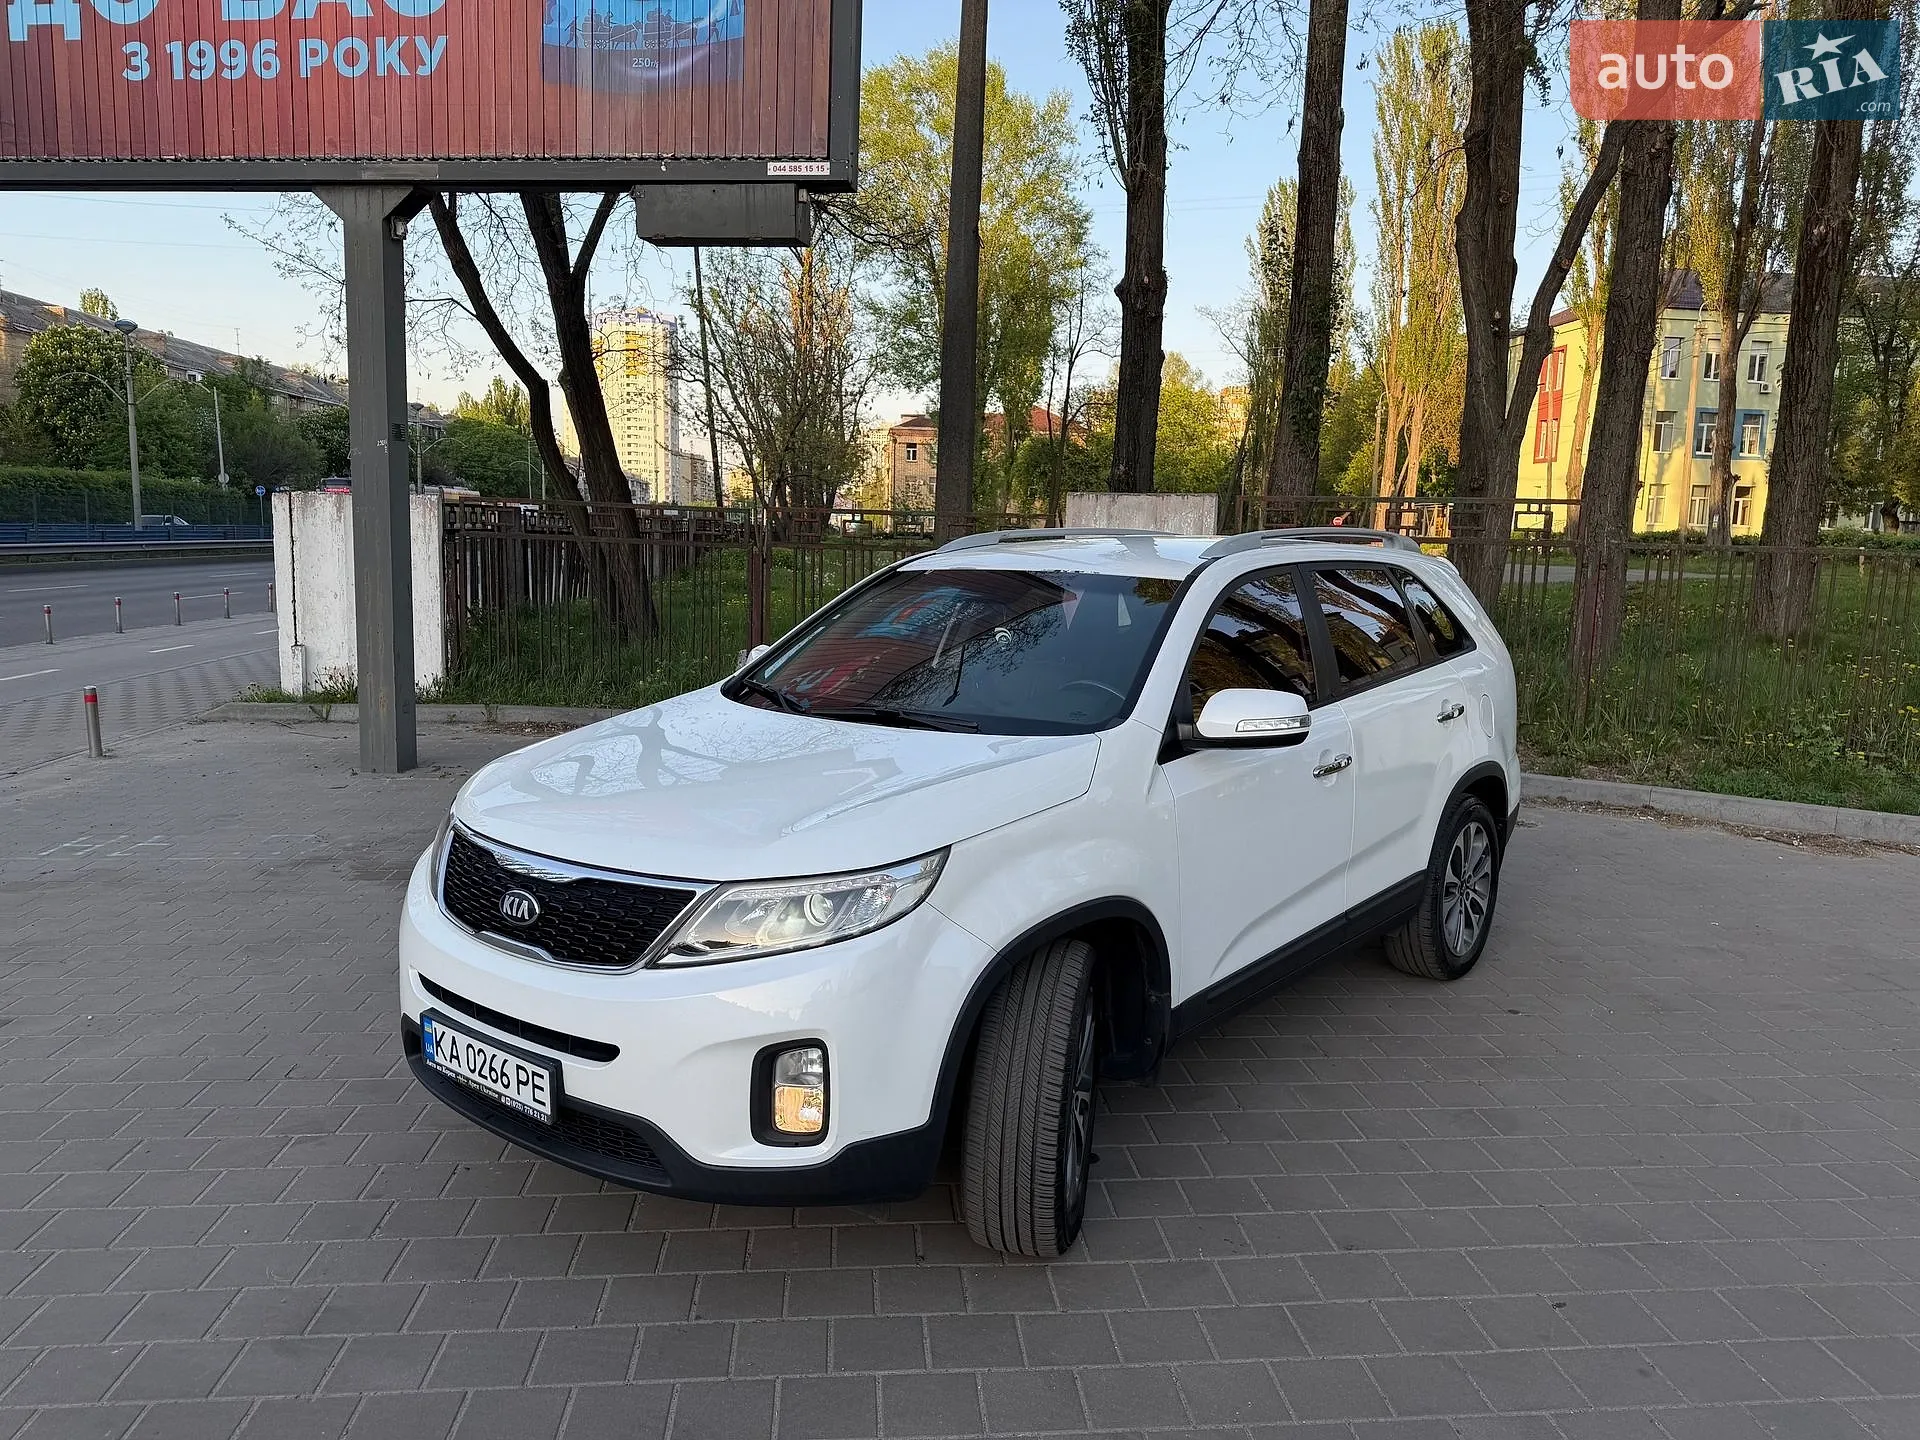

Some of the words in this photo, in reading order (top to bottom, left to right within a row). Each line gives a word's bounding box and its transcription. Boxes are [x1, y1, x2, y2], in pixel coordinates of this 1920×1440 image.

[165, 39, 281, 80] 1996
[299, 35, 449, 78] РОКУ
[503, 894, 529, 920] KIA
[426, 1042, 434, 1054] UA
[433, 1026, 462, 1069] KA
[465, 1042, 511, 1090] 0266
[515, 1063, 547, 1107] PE
